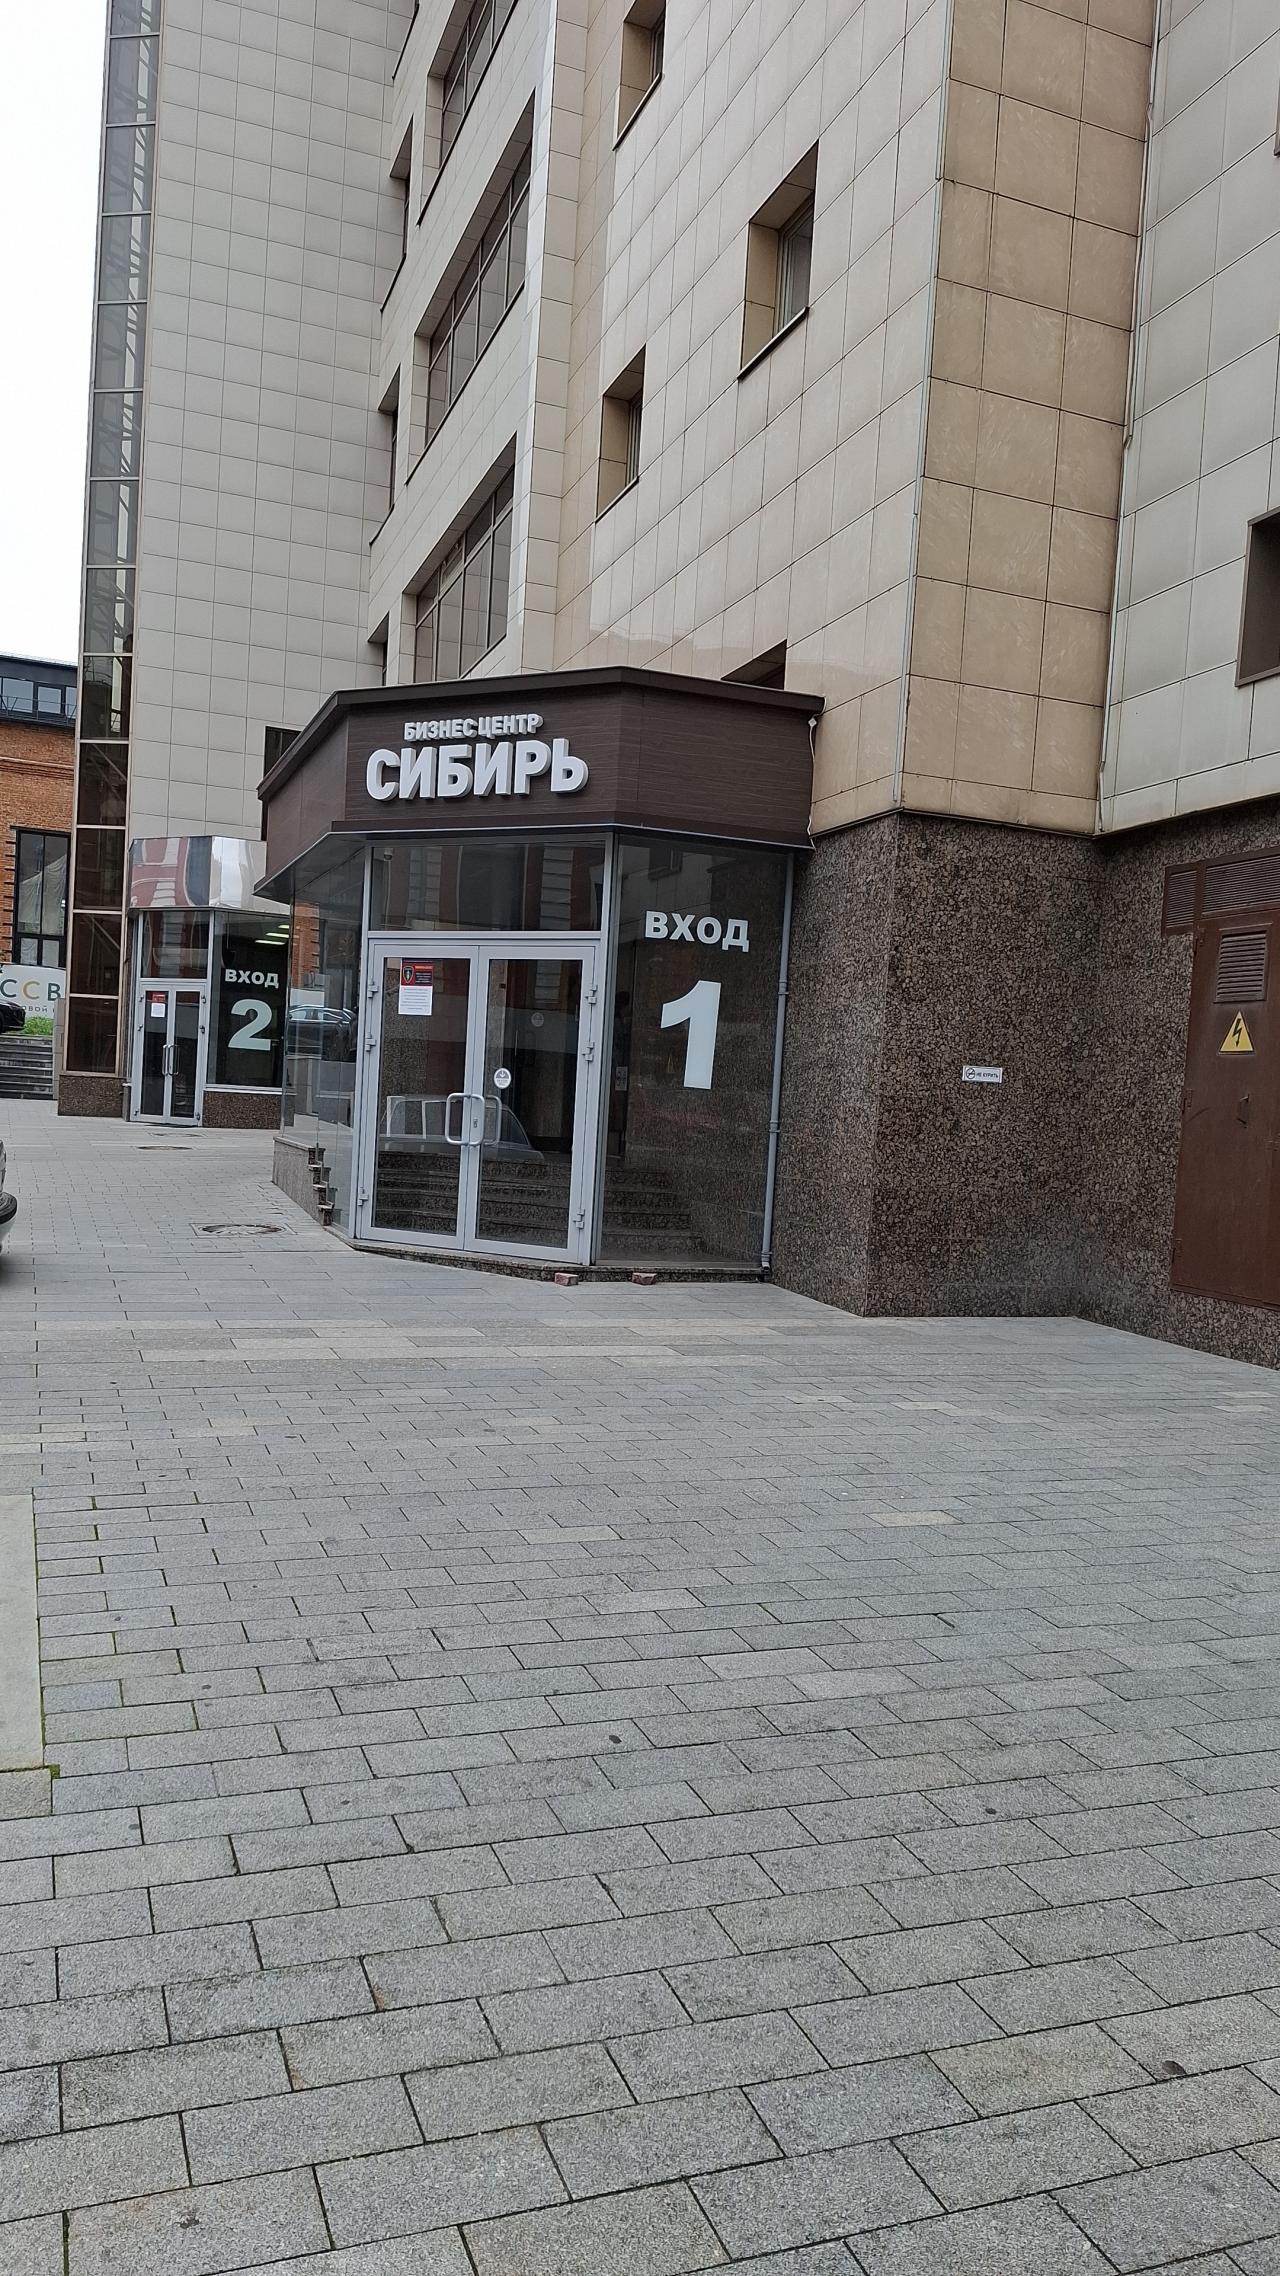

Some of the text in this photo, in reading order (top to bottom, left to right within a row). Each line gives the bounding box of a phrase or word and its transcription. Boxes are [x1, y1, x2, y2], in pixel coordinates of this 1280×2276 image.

[404, 713, 543, 741] БИЗНЕС ЦЕНТР
[366, 738, 589, 801] СИБИРЬ
[644, 910, 750, 953] ВХОД
[224, 968, 279, 989] ВХОД
[228, 998, 273, 1051] 2
[660, 980, 722, 1090] 1
